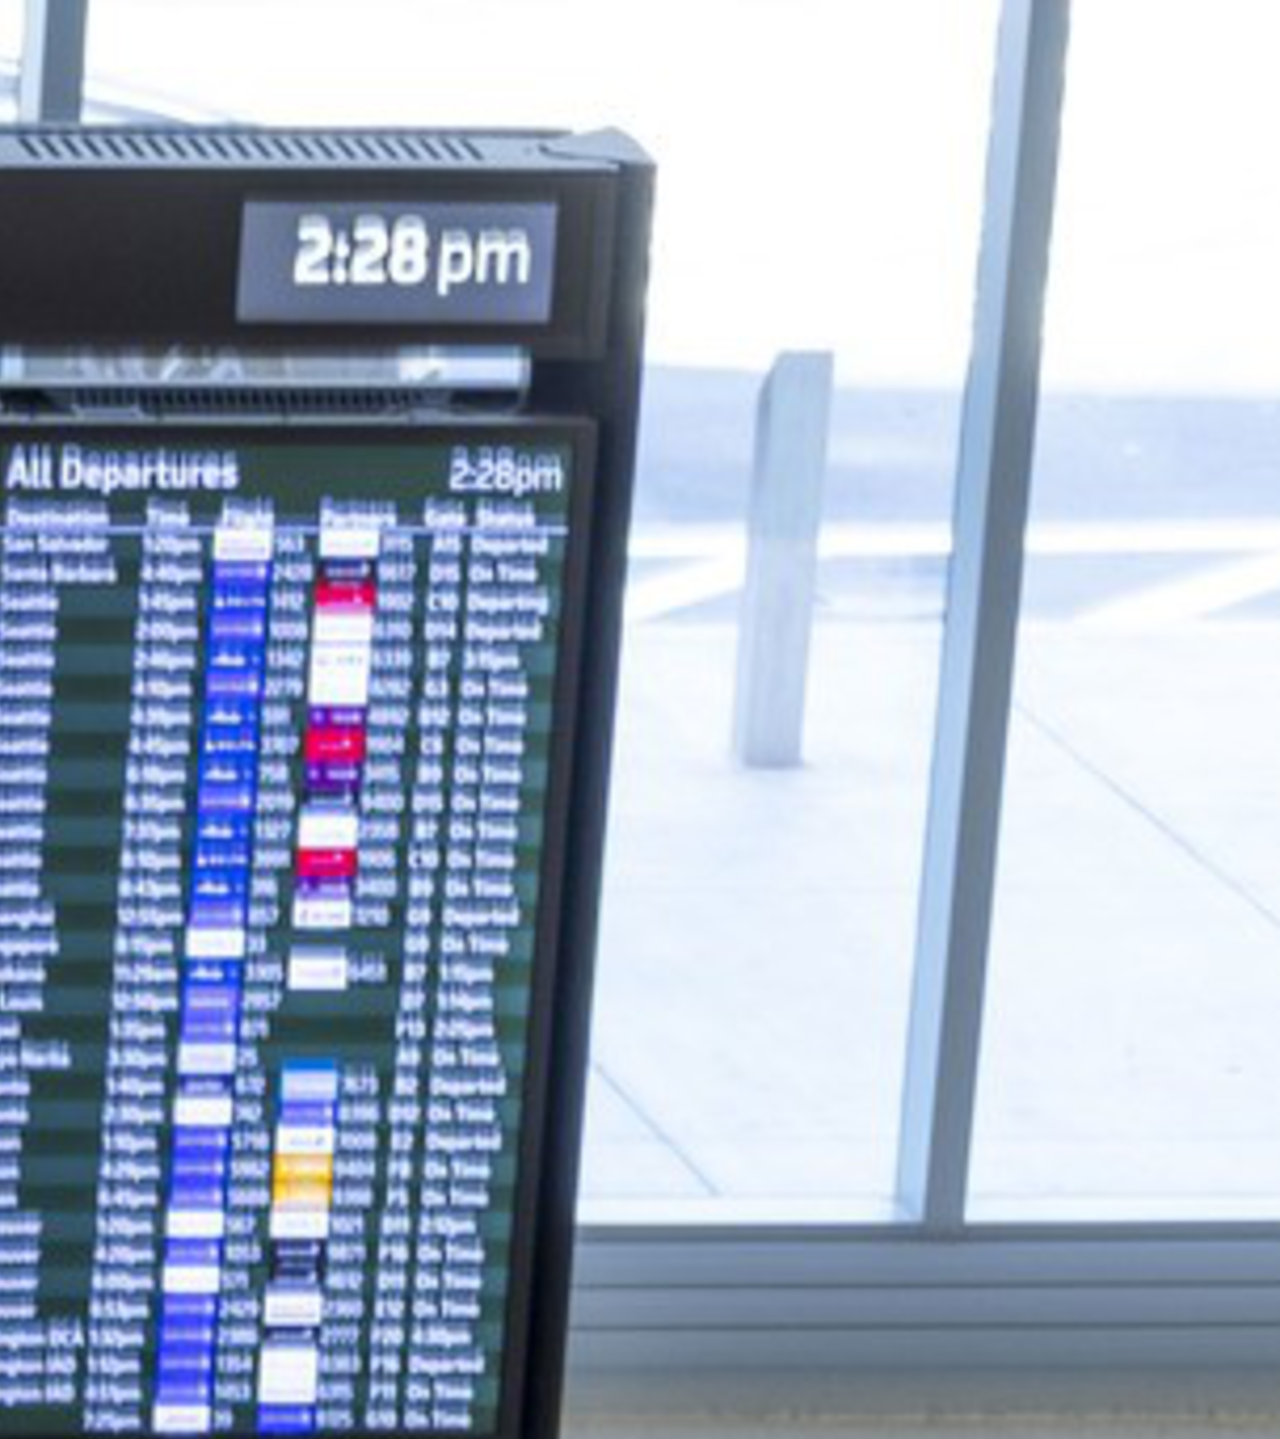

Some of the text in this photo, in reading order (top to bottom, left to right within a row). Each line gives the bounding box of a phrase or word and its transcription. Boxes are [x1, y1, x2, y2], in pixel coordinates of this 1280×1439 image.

[293, 216, 531, 295] 2:28 pm
[7, 451, 240, 492] All Departures
[449, 454, 564, 495] 2:28pm
